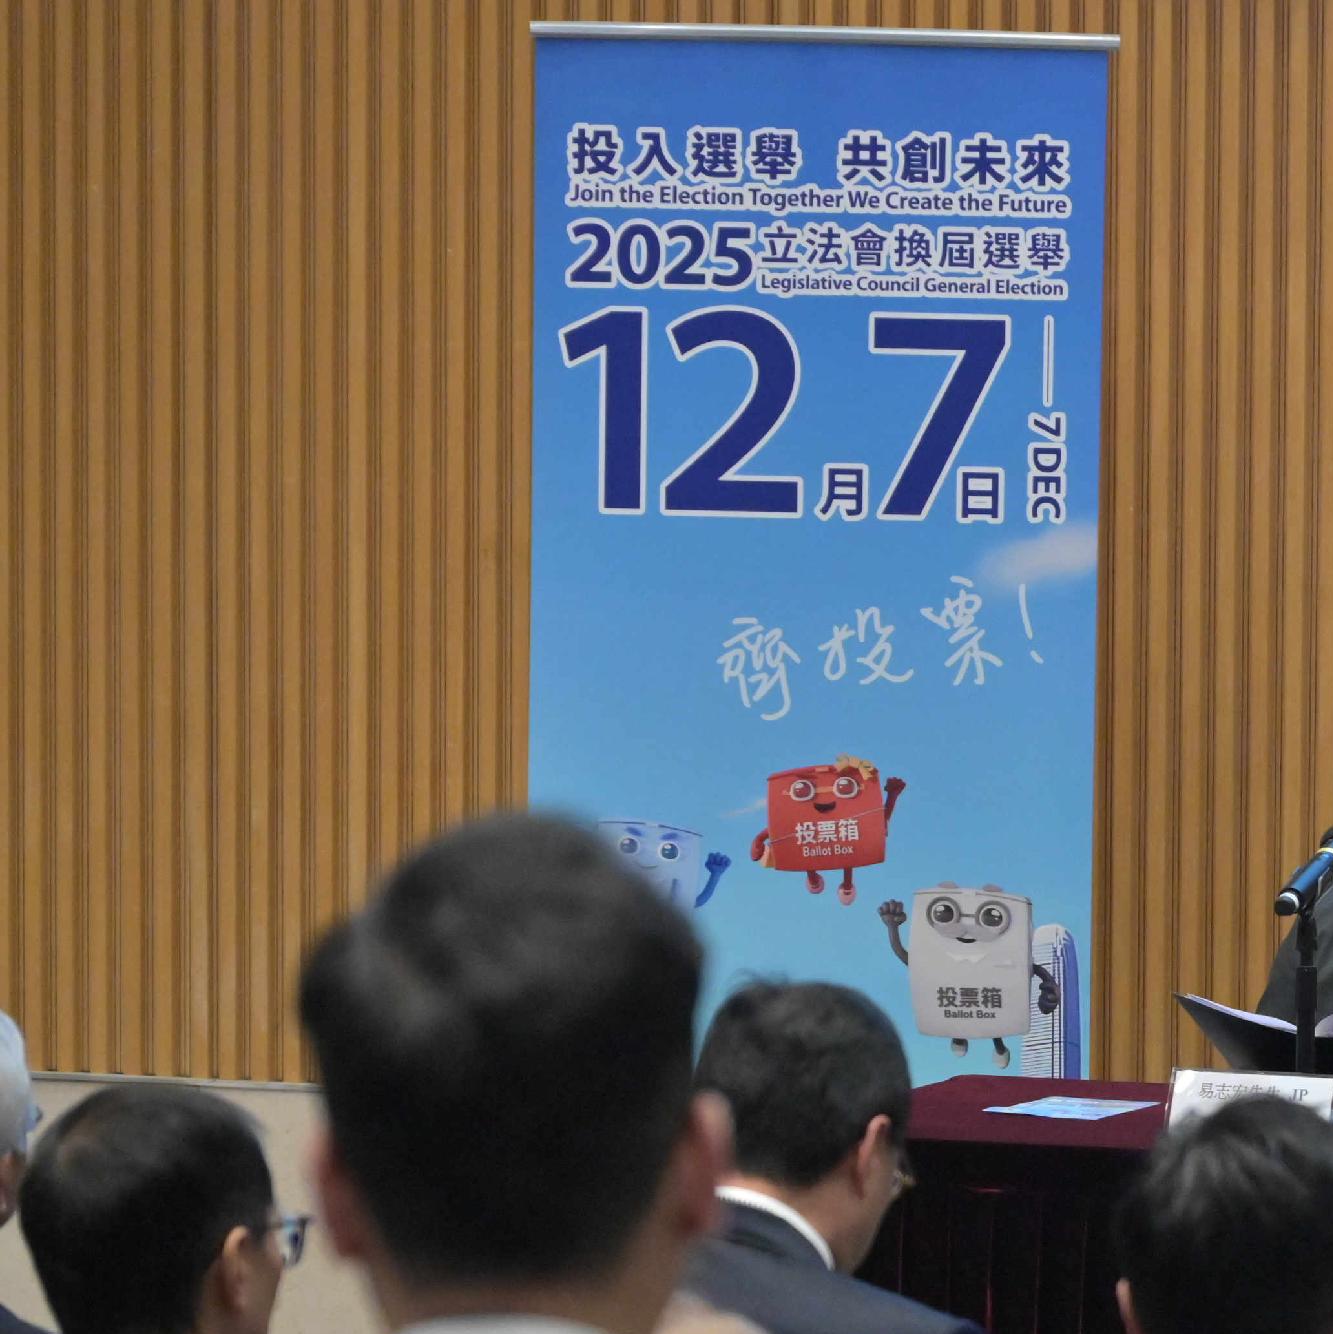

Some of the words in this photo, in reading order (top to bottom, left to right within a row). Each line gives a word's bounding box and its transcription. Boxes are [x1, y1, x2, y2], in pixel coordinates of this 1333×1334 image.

[572, 128, 797, 180] 投入選舉
[841, 135, 1065, 187] 共創未來
[570, 184, 613, 203] Join
[619, 185, 654, 204] the
[660, 185, 744, 206] Election
[748, 188, 844, 212] Together
[848, 190, 880, 209] We
[885, 191, 953, 211] Create
[958, 192, 993, 212] the
[998, 194, 1068, 214] Future
[761, 274, 853, 293] Legislative
[856, 276, 920, 293] Council
[924, 277, 991, 295] General
[995, 279, 1064, 296] Election
[563, 310, 1006, 519] 12月7日
[1033, 416, 1061, 437] 7
[1032, 447, 1062, 520] DEC
[795, 818, 860, 845] 投票箱
[802, 846, 832, 858] Ballot
[834, 844, 854, 855] Box
[937, 986, 1003, 1009] 投票箱
[943, 1009, 974, 1019] Ballot
[976, 1009, 996, 1019] Box
